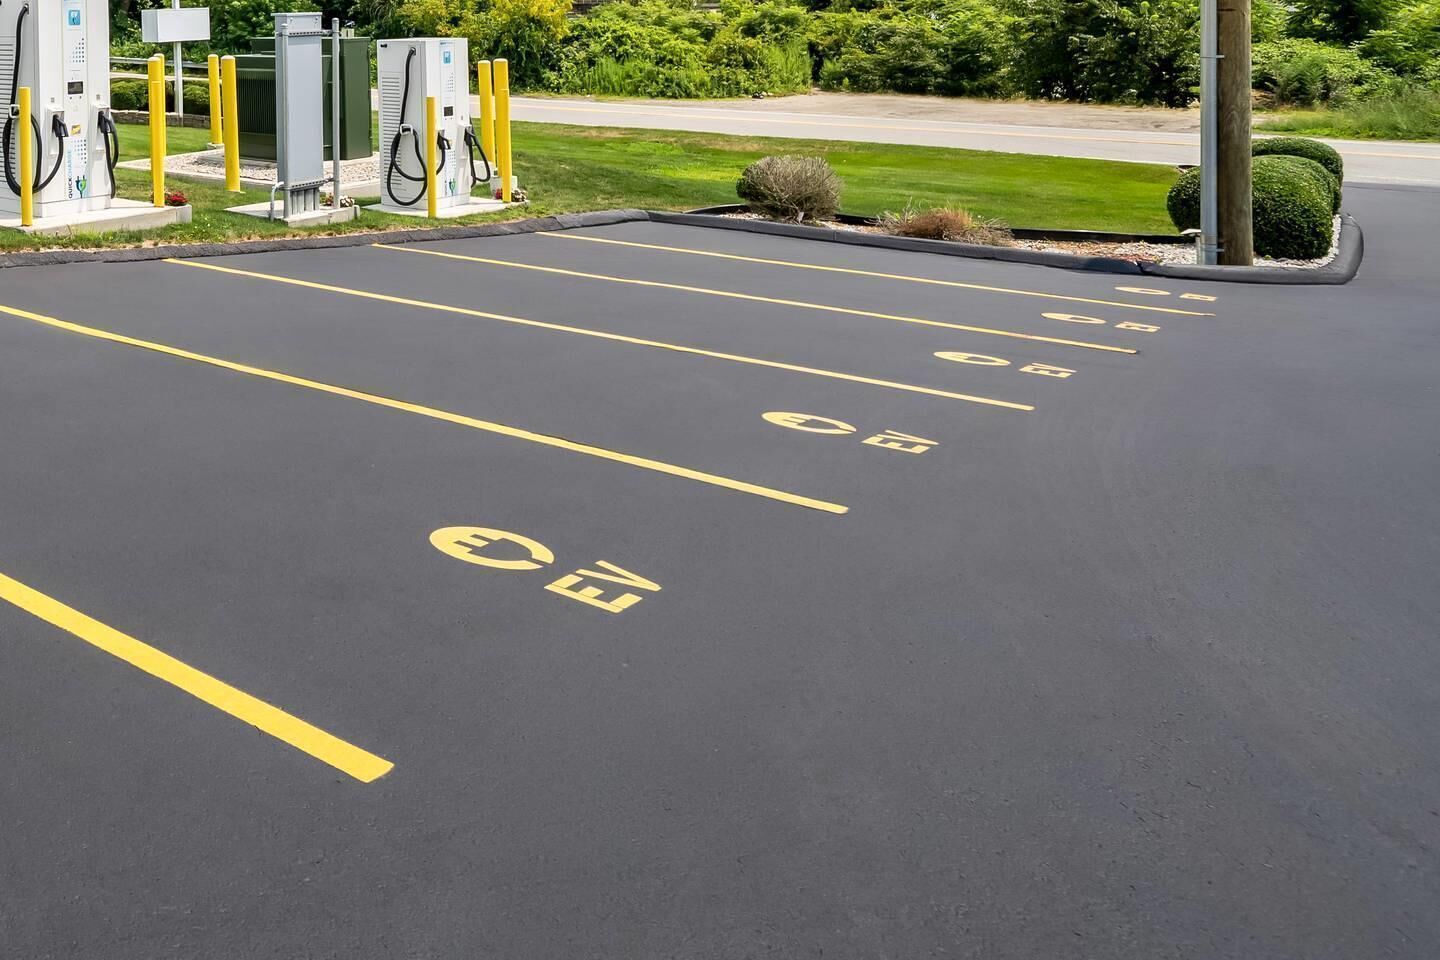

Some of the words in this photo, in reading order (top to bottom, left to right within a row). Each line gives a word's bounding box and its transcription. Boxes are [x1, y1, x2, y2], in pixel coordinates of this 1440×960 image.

[1019, 362, 1077, 379] EV
[862, 429, 940, 455] EV
[543, 559, 662, 614] EV
